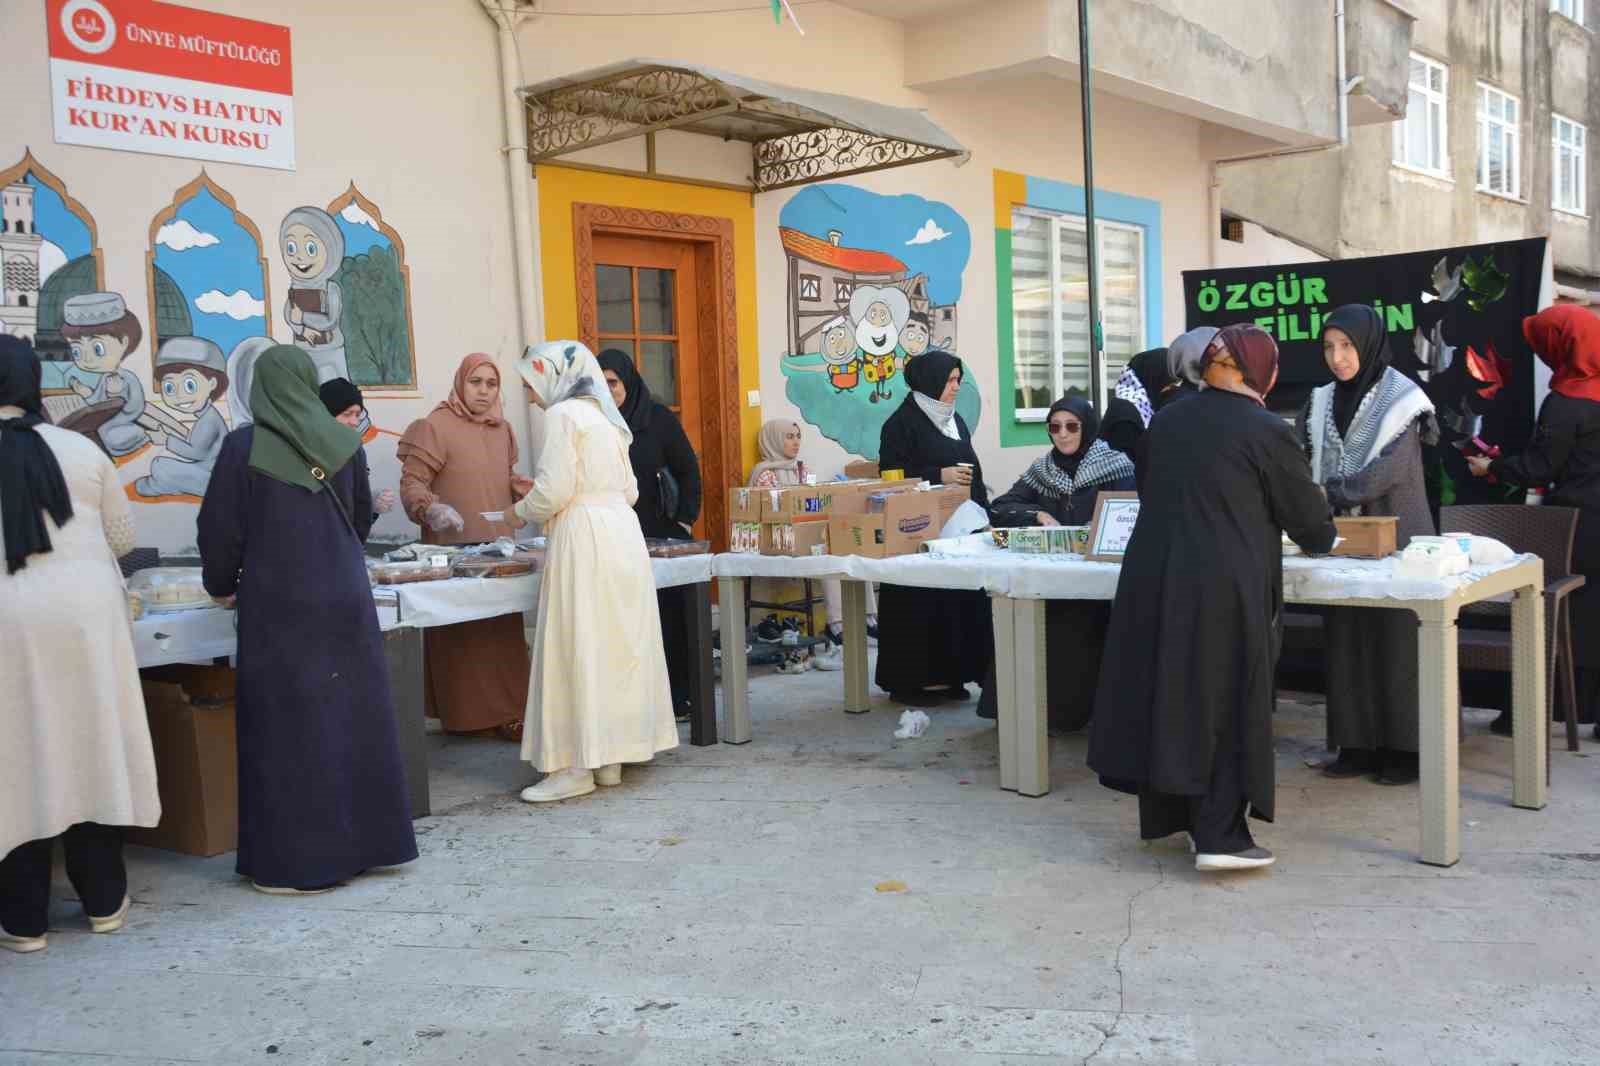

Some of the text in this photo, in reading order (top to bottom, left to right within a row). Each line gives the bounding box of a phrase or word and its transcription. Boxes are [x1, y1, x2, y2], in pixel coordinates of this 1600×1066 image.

[126, 22, 281, 66] ÜNYE MÜFTÜLÜĞÜ
[66, 76, 283, 127] FİRDEVS HATUN
[68, 107, 270, 150] KUR'AN KURSU
[1198, 273, 1328, 312] ÖZGÜR
[1254, 299, 1414, 341] FİLİN
